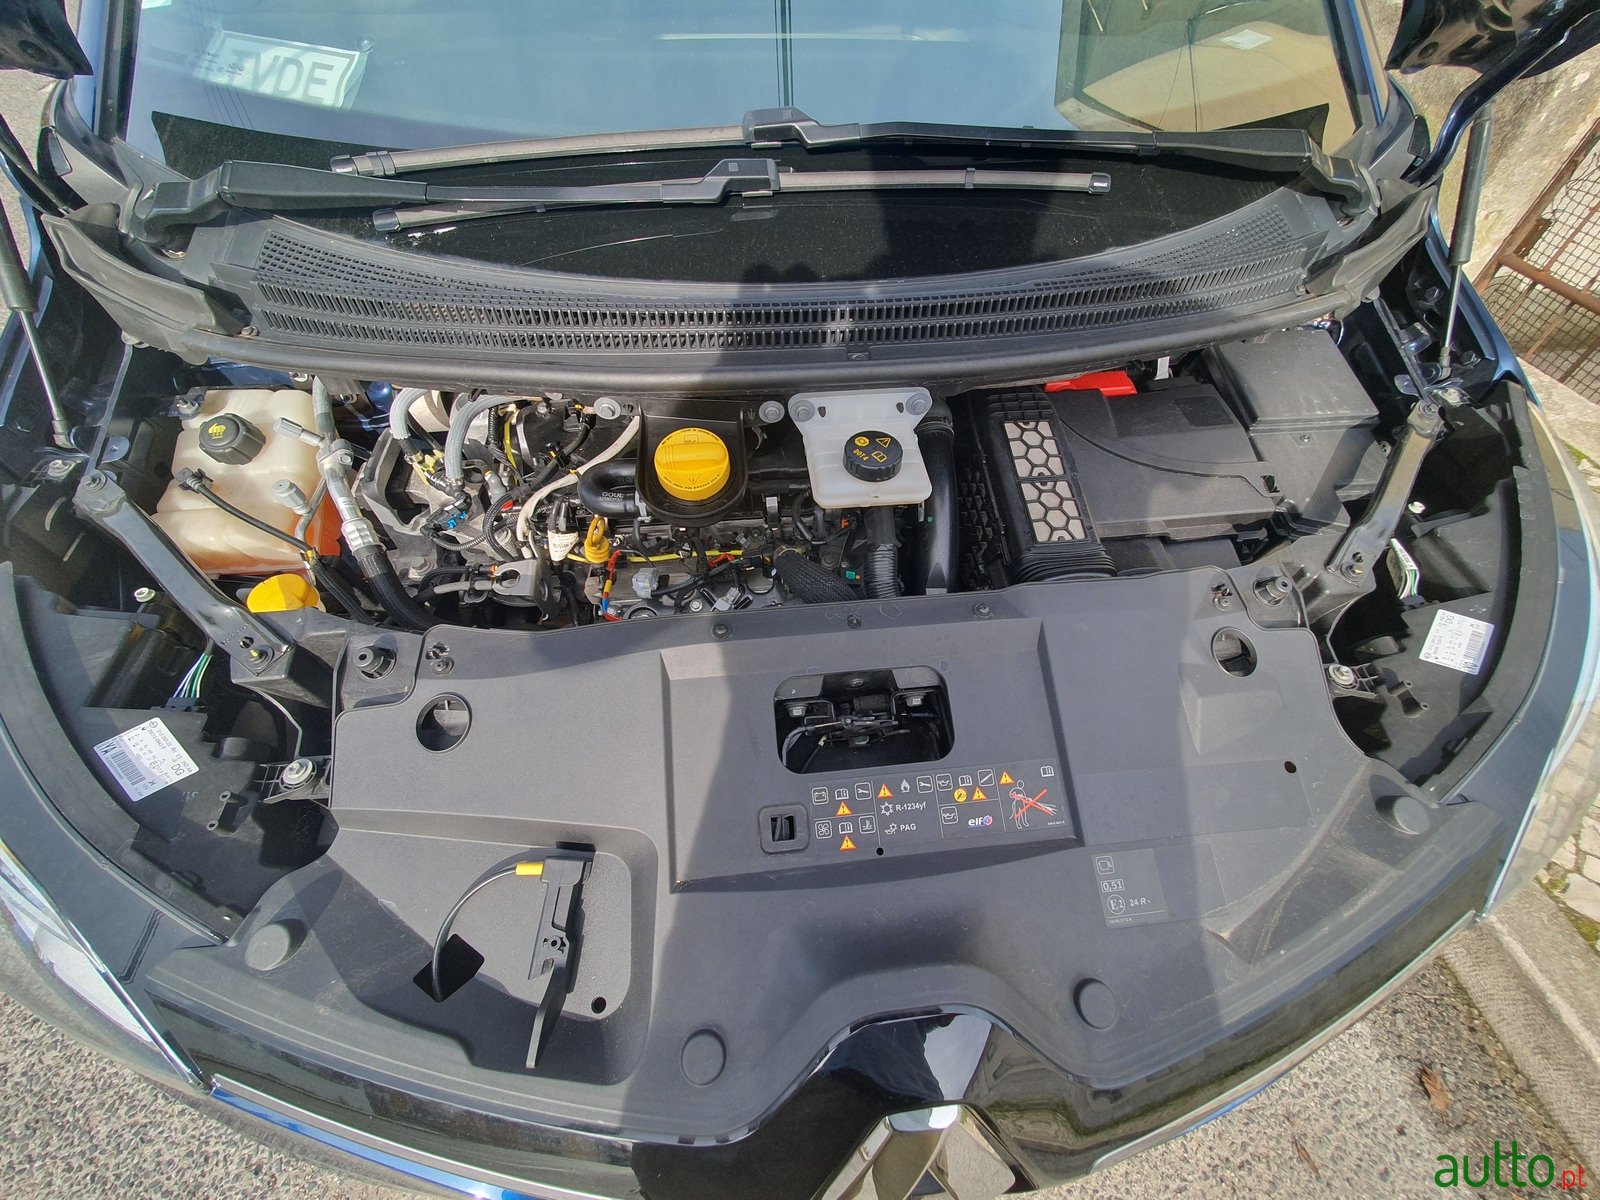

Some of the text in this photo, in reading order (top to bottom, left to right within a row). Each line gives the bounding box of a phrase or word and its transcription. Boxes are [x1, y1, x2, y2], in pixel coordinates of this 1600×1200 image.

[227, 49, 335, 103] TVDE
[171, 763, 185, 776] DG
[895, 801, 927, 812] R-1234yf
[967, 816, 983, 827] elf
[899, 823, 917, 832] PAG
[1102, 880, 1123, 891] 0,51
[1129, 898, 1139, 907] 24
